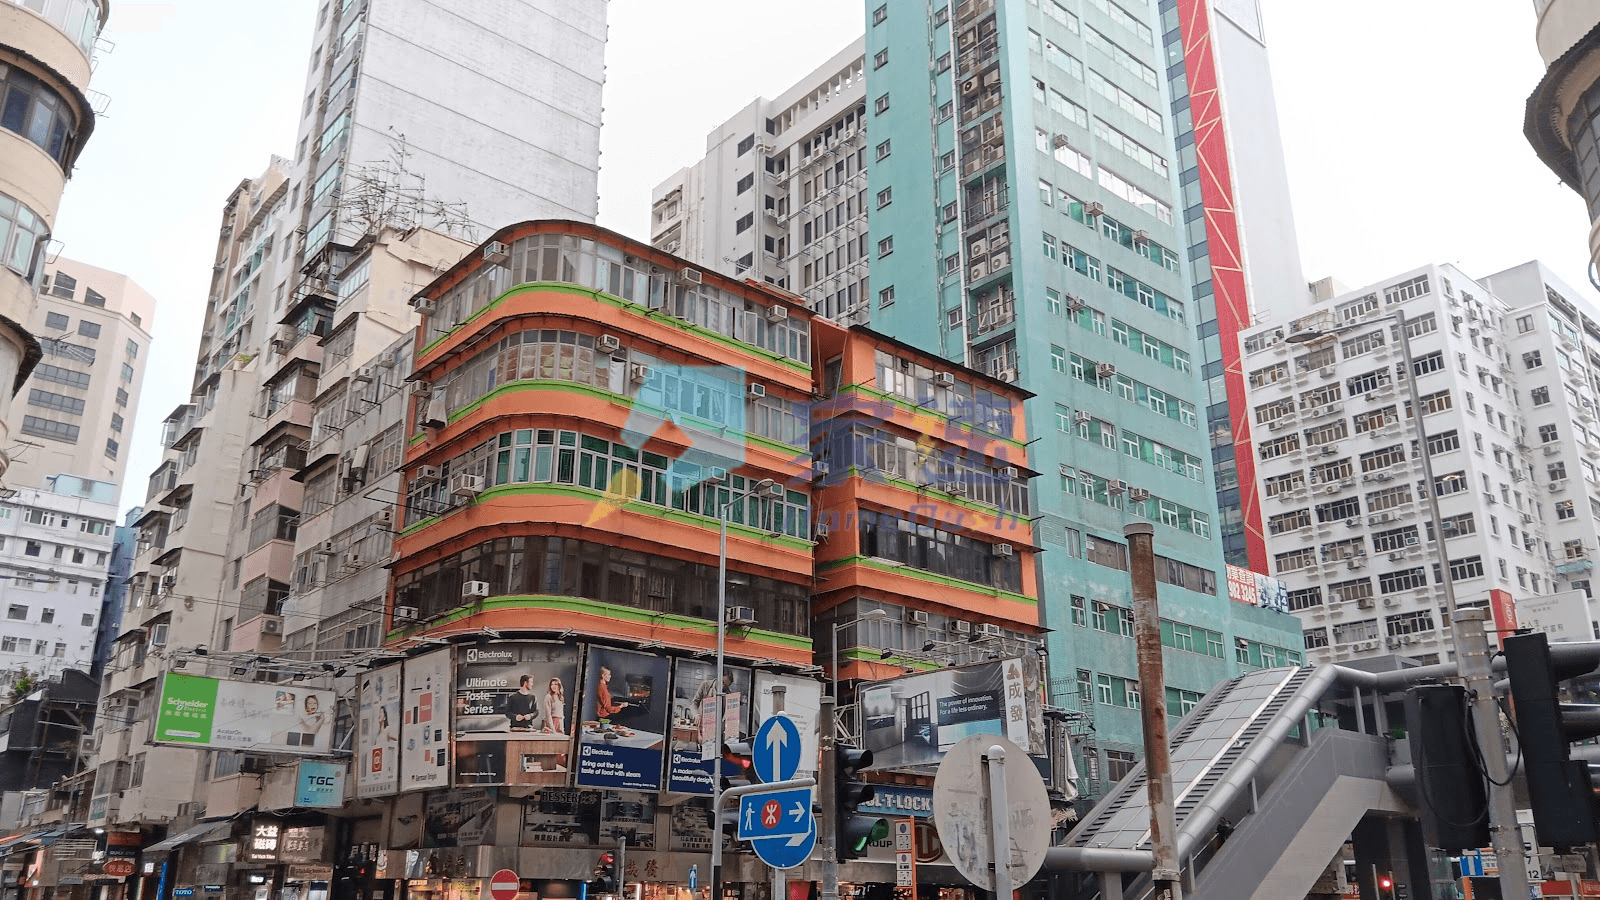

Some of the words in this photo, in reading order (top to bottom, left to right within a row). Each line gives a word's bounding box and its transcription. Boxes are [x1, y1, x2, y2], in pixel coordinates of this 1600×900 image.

[479, 651, 512, 659] Electrolux
[466, 678, 507, 687] Ultimate
[466, 691, 490, 700] Taste
[968, 695, 993, 703] innovation.
[167, 697, 208, 708] Schneider
[1009, 683, 1024, 722] 成發
[464, 704, 494, 714] Series
[968, 704, 987, 712] ordinary.
[582, 760, 596, 768] Bring
[308, 776, 334, 785] TGC
[542, 791, 579, 803] BESSER
[256, 825, 278, 838] 大益
[1528, 870, 1540, 878] 12
